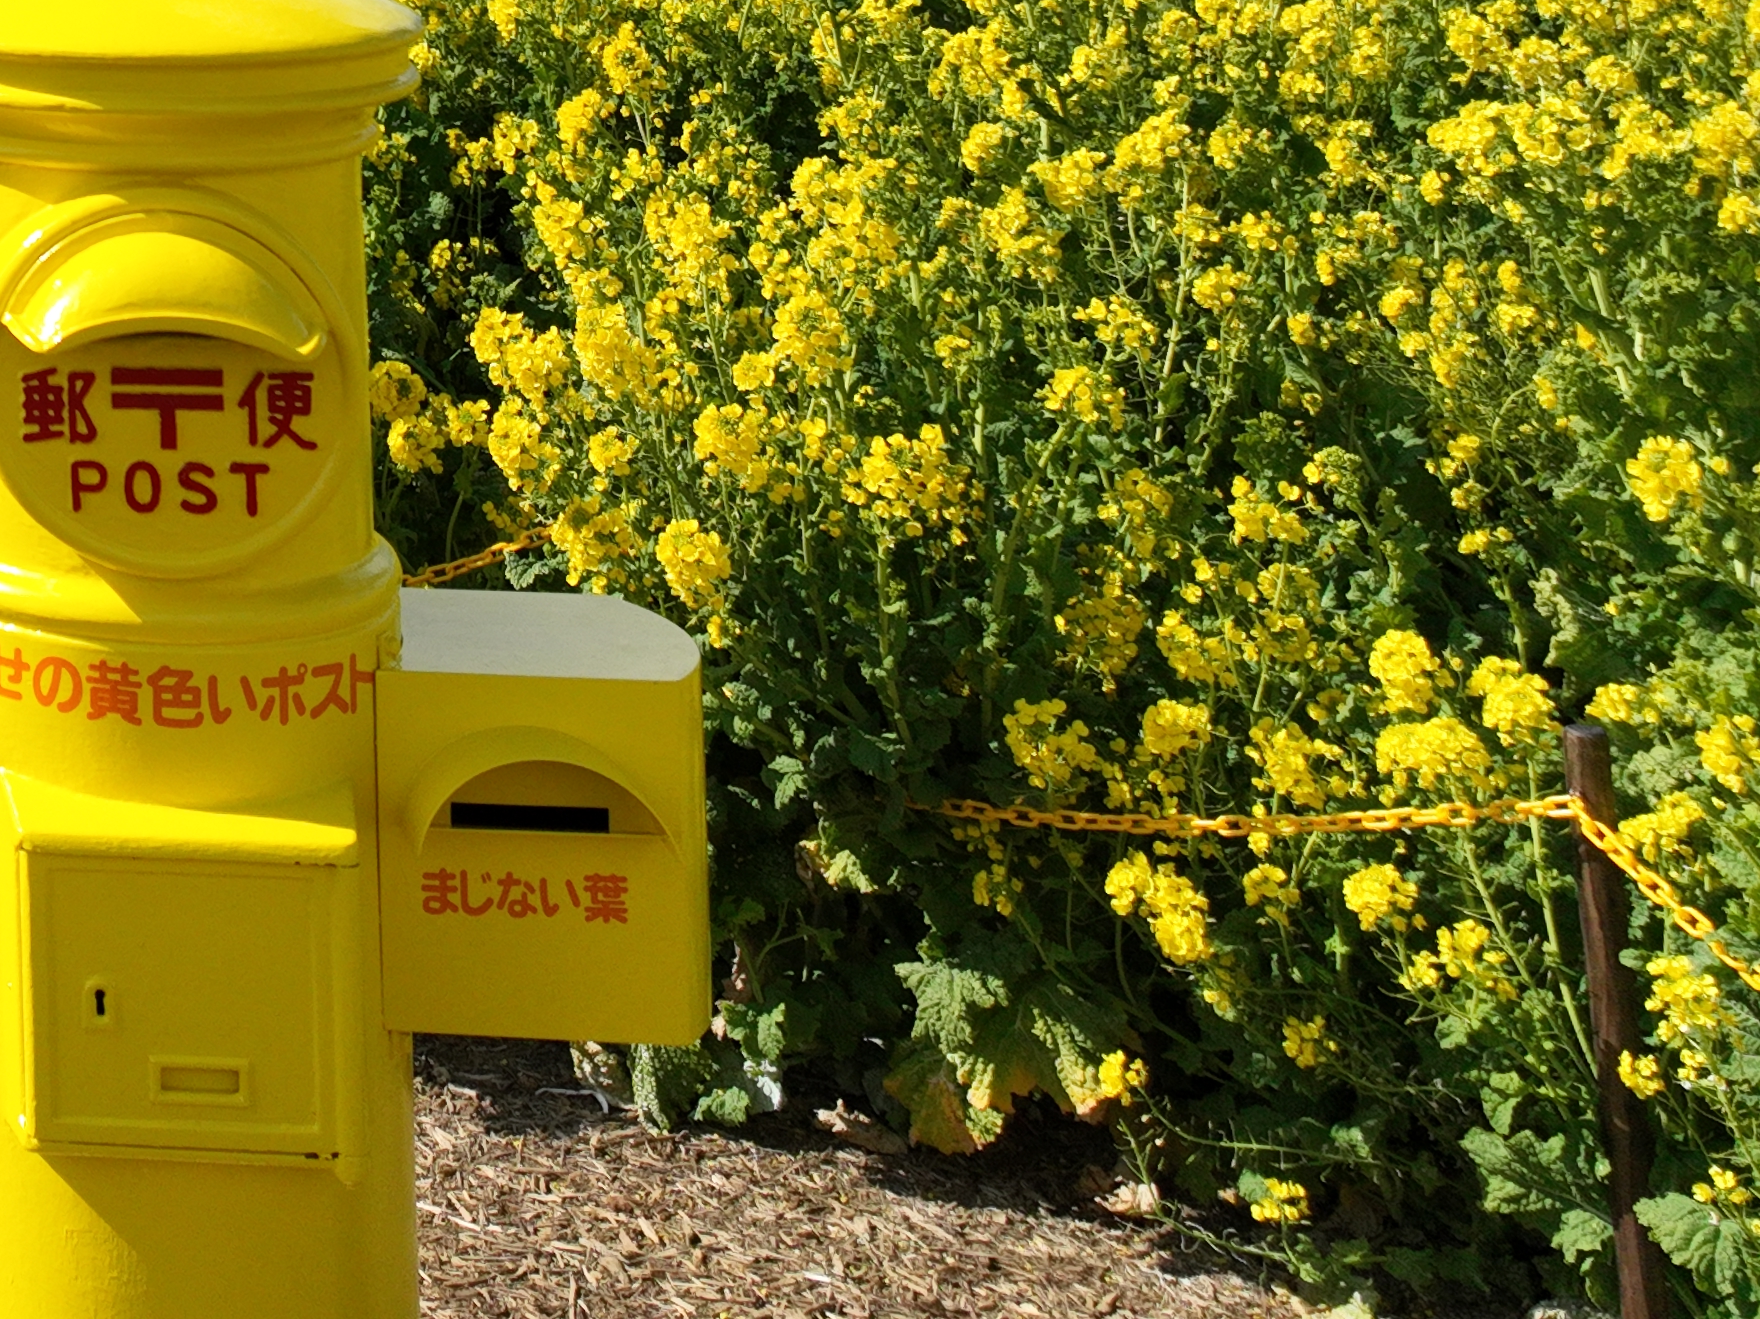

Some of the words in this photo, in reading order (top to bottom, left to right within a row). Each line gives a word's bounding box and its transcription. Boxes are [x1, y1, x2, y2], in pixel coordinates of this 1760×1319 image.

[71, 461, 270, 517] POST
[421, 868, 629, 924] まじない葉
